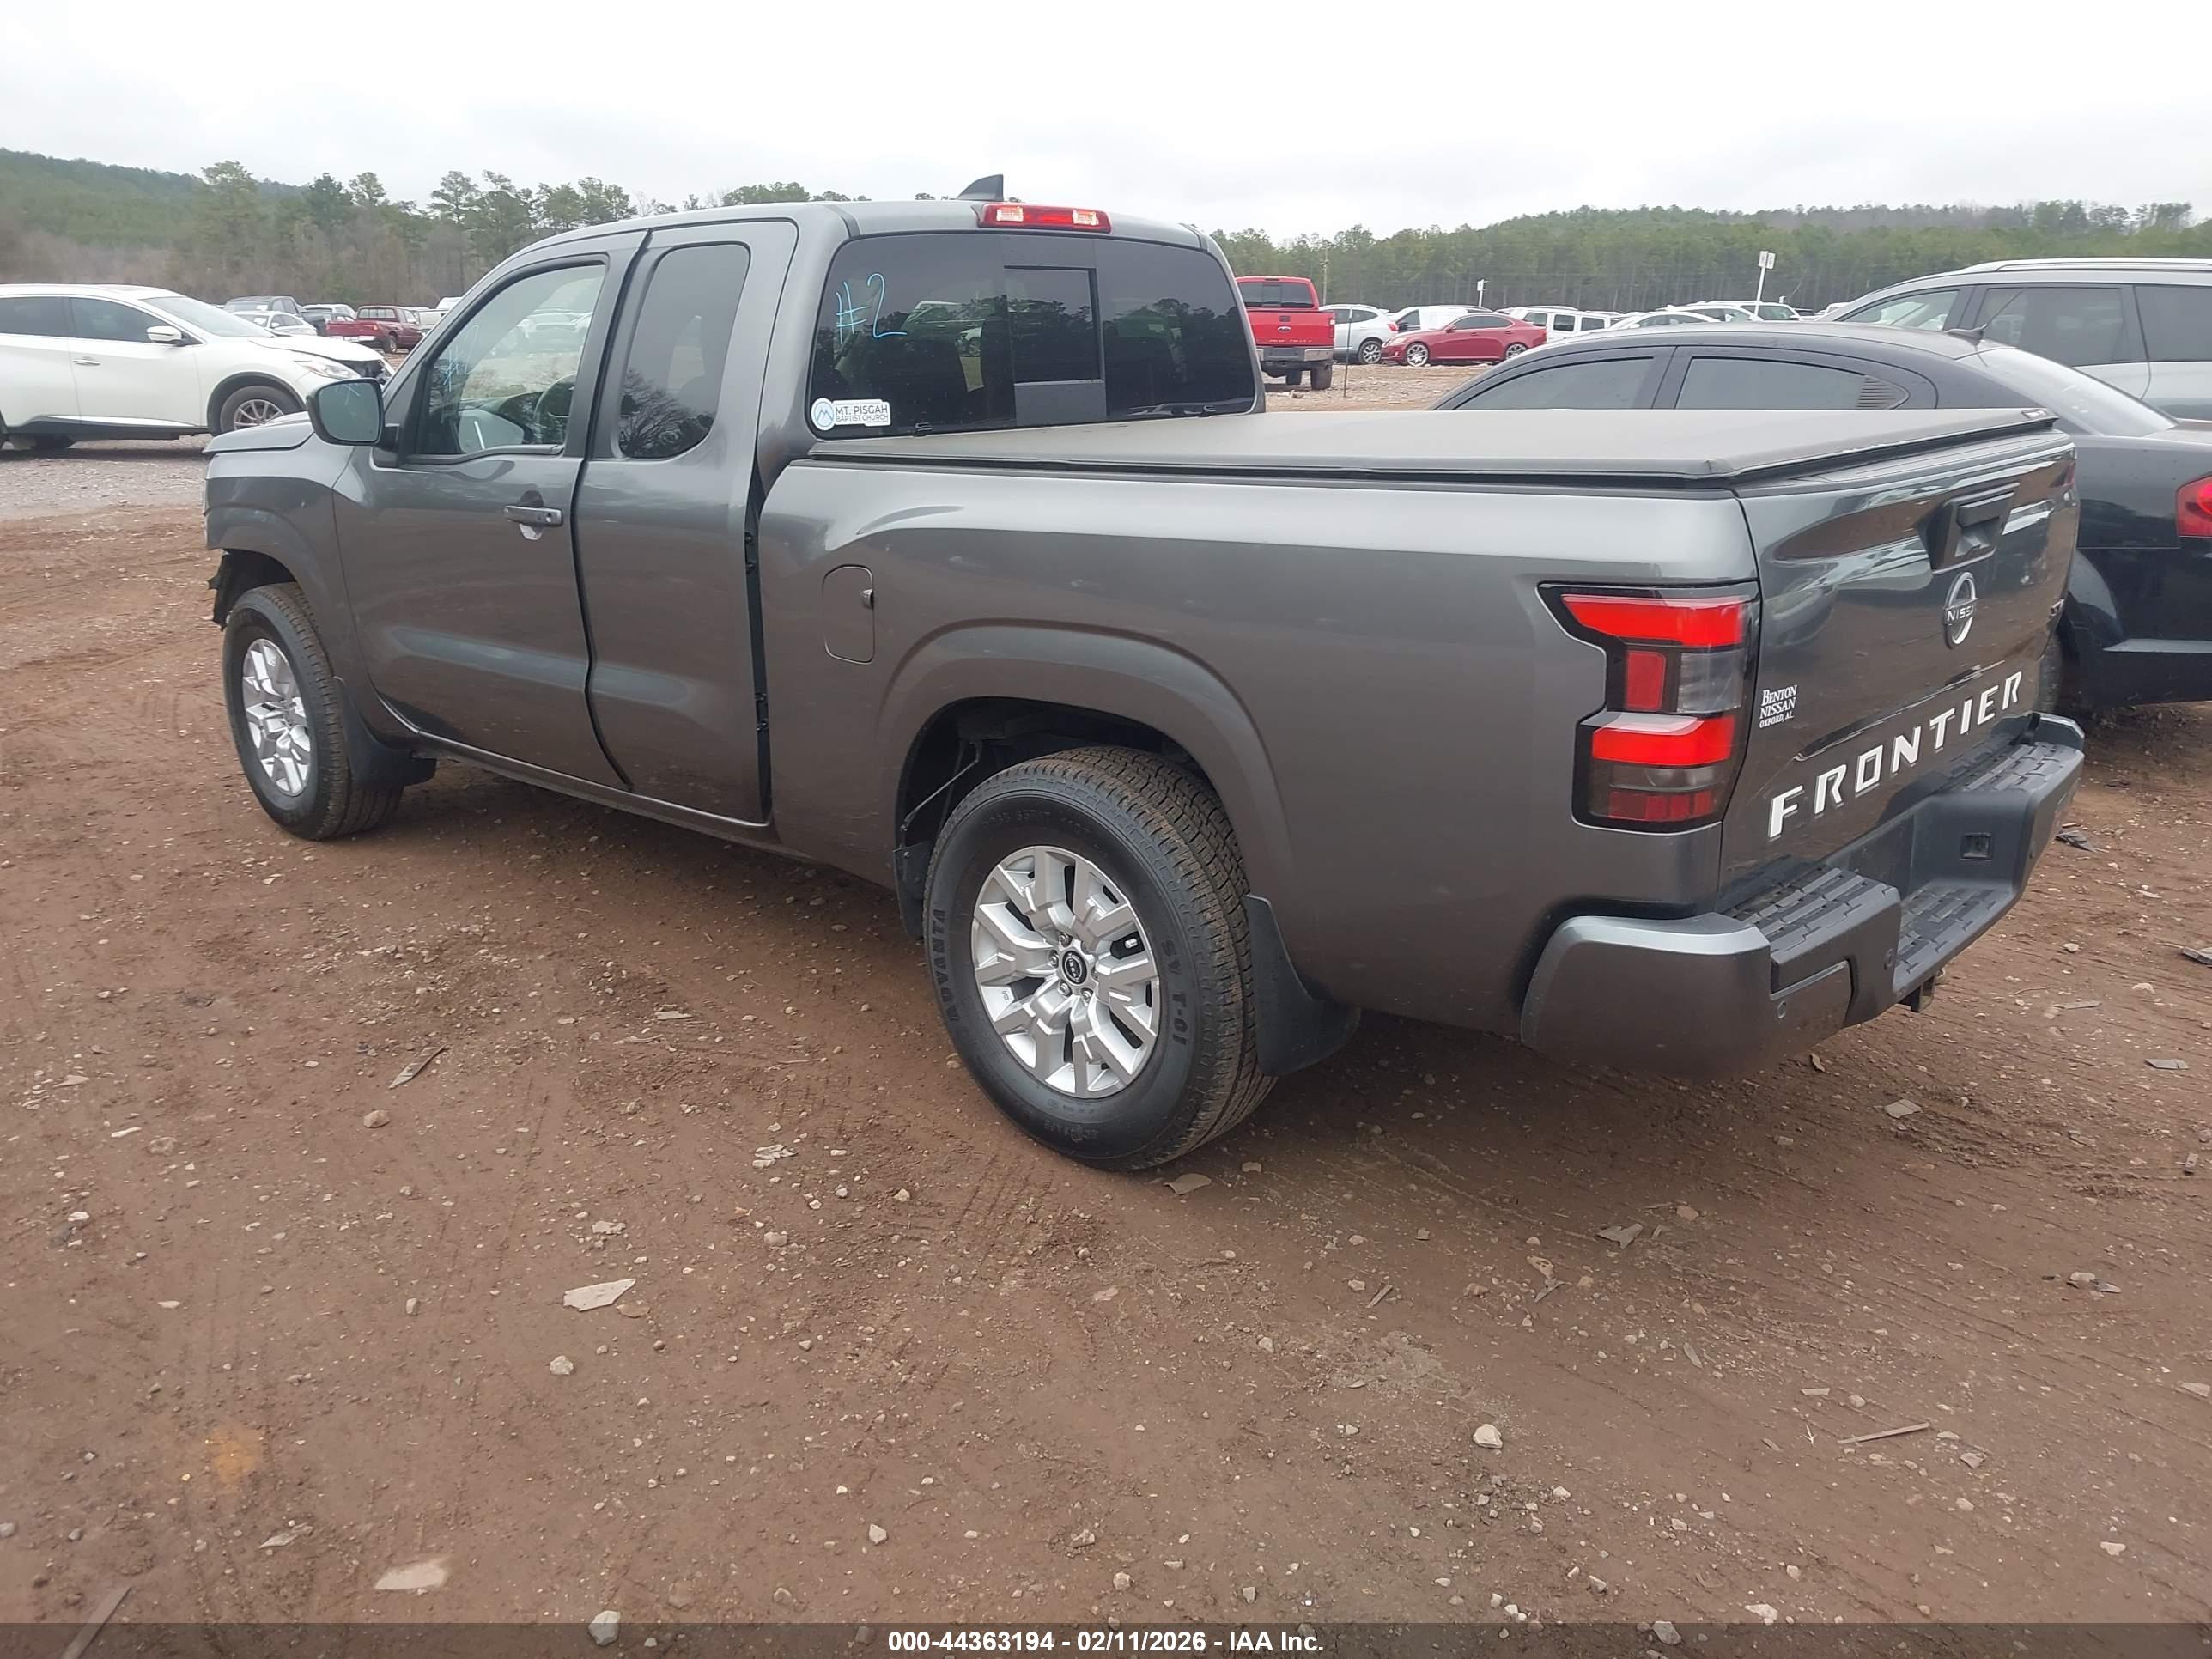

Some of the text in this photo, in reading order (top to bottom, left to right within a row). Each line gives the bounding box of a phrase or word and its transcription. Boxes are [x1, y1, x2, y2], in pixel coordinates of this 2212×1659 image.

[836, 273, 908, 345] #2
[836, 404, 888, 416] MT. PISGAH
[1946, 605, 1974, 622] NISS
[1759, 697, 1796, 720] NISSAN
[1767, 670, 2023, 842] FRONTIER
